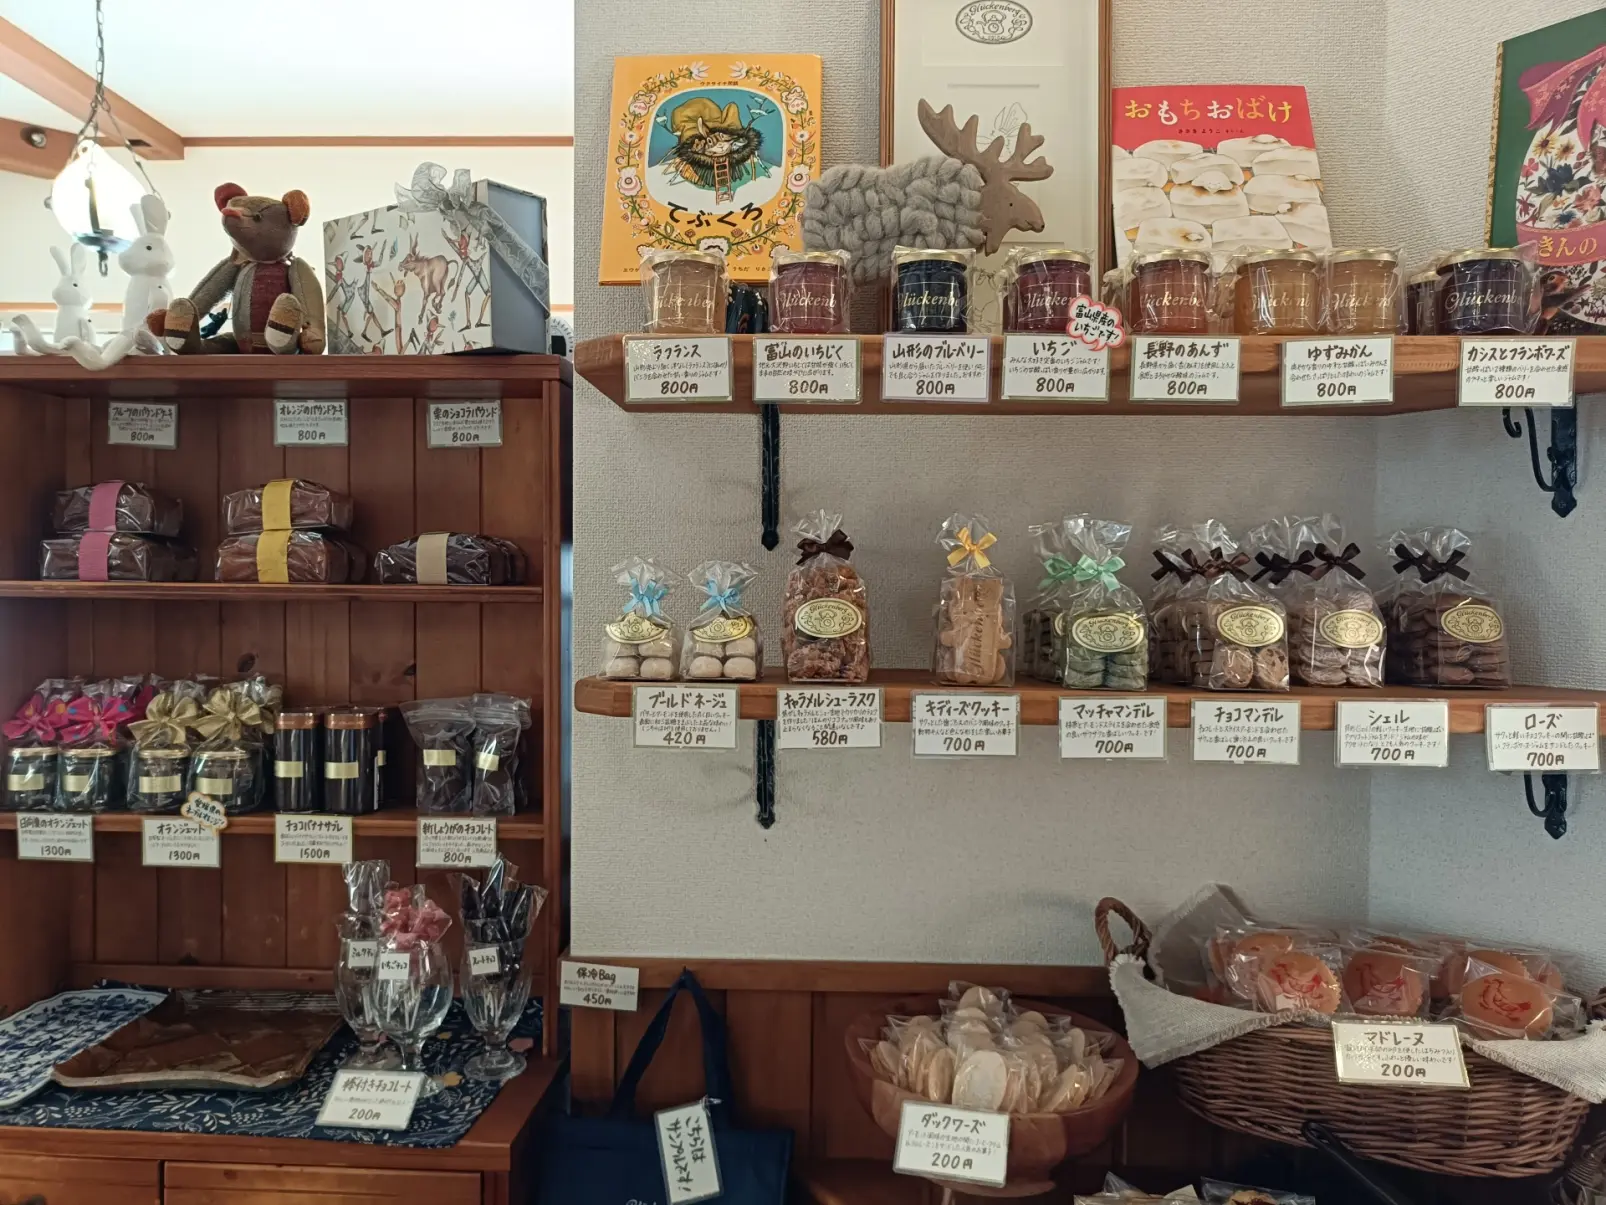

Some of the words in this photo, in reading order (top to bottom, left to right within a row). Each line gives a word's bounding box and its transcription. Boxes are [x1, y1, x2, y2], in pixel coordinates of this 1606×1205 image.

[1124, 94, 1292, 126] おもちおばけ
[667, 201, 763, 228] てぶくろ
[652, 344, 703, 361] ラフランス
[764, 342, 844, 361] 富山のいちじく
[892, 340, 985, 360] 山形のブルーベリー
[1033, 340, 1077, 357] いちご
[1143, 341, 1230, 360] 長野のあんず
[1308, 344, 1373, 362] ゆずみかん
[1467, 344, 1571, 362] カシスとフランボワーズ
[660, 380, 699, 395] 800円
[789, 380, 828, 395] 800円
[916, 379, 956, 396] 800円
[1036, 377, 1075, 393] 800円
[1167, 381, 1208, 396] 800円
[1317, 381, 1356, 398] 800円
[1495, 383, 1536, 399] 800円
[297, 429, 326, 441] 800円
[451, 432, 480, 443] 800円
[648, 691, 727, 709] ブールドネージュ
[783, 692, 876, 710] キャラメルシューラスク
[925, 700, 1010, 718] キディーズクッキー
[1072, 702, 1154, 719] マッチャマンデル
[1213, 706, 1284, 723] チョコマンデル
[1368, 709, 1410, 726] シェル
[1524, 713, 1563, 730] ローズ
[662, 731, 706, 745] 420円
[812, 730, 848, 746] 580円
[943, 736, 985, 752] 700円
[1095, 739, 1133, 754] 700円
[1226, 744, 1267, 759] 700円
[1370, 747, 1415, 761] 700円
[1526, 752, 1565, 767] 700円
[156, 822, 206, 835] オランジェット
[422, 822, 494, 835] 新しょうがのチョコレート
[40, 845, 72, 856] 1300円
[168, 850, 200, 861] 1300円
[299, 847, 331, 859] 1500円
[443, 851, 472, 863] 800円
[582, 993, 612, 1006] 450円
[1363, 1030, 1425, 1047] マドレーヌ
[1380, 1063, 1427, 1078] 200円
[347, 1107, 381, 1121] 200円
[920, 1111, 987, 1135] ダックワーズ
[931, 1151, 973, 1170] 200円
